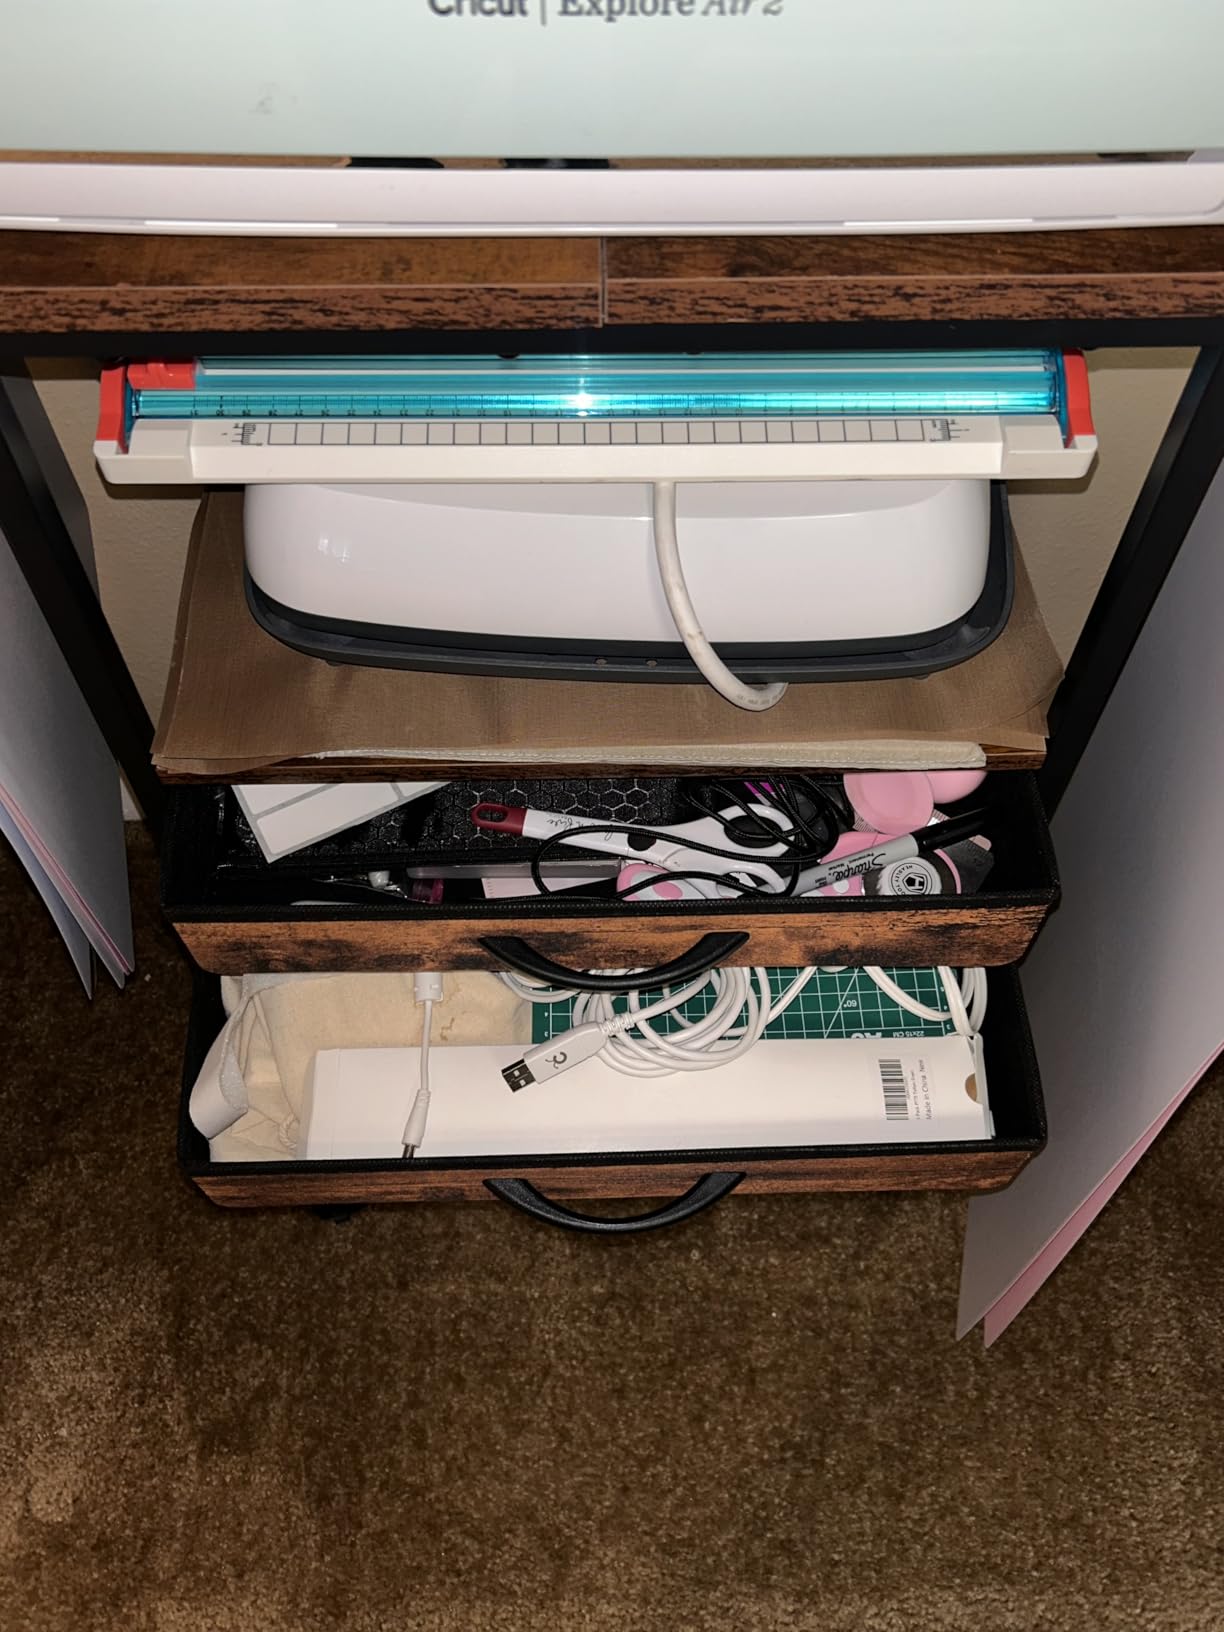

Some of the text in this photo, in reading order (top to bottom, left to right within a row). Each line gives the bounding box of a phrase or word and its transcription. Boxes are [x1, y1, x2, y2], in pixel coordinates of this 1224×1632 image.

[428, 0, 528, 17] Cricut
[558, 0, 695, 23] Explore
[921, 1074, 929, 1093] China
[923, 1101, 933, 1120] Made
